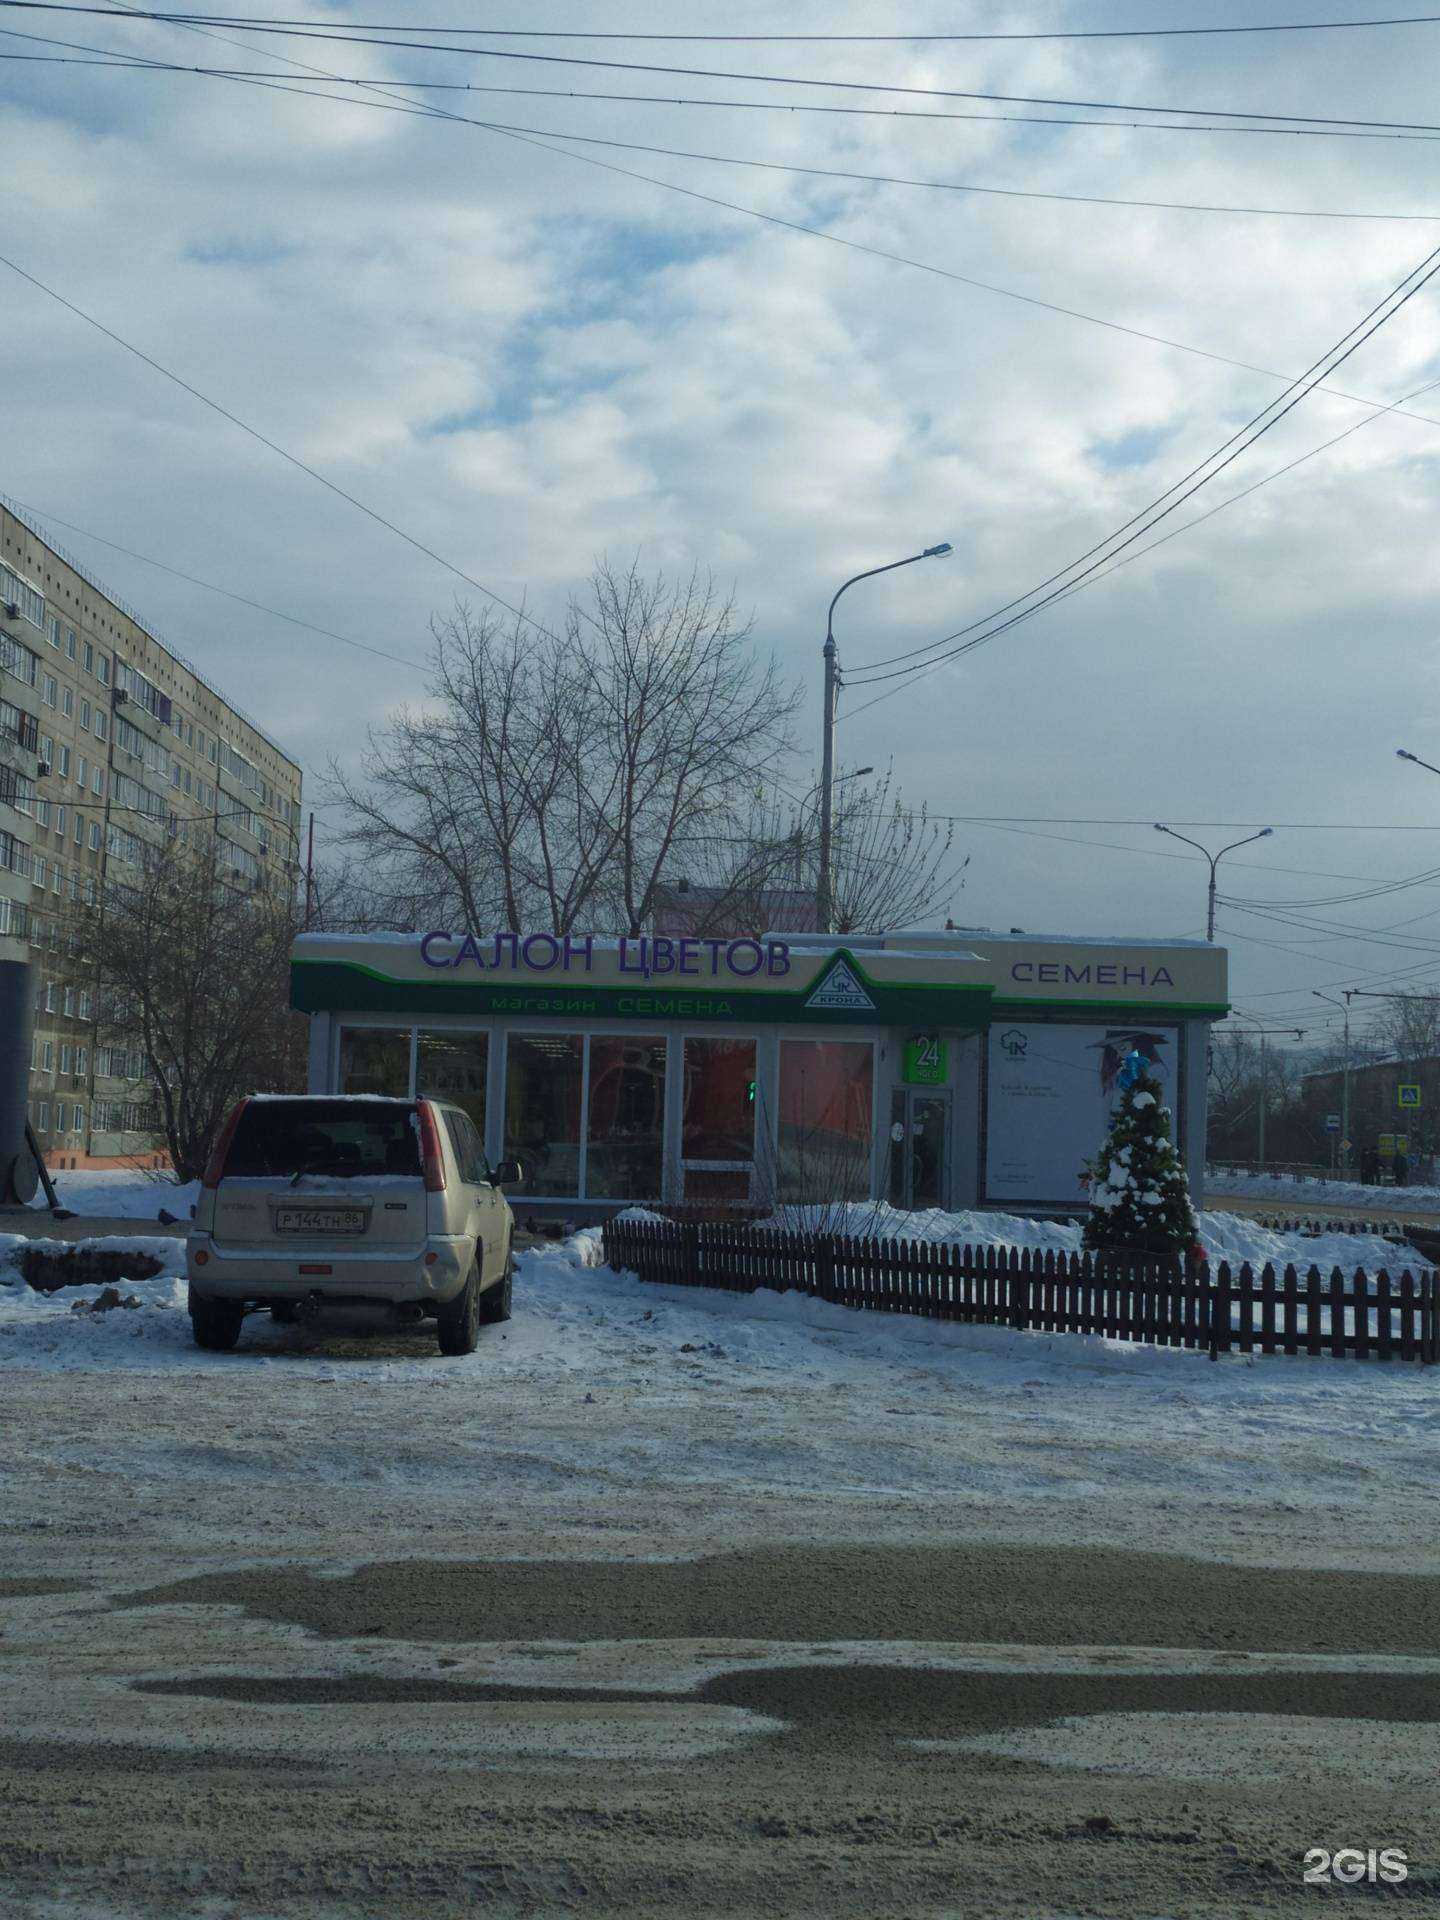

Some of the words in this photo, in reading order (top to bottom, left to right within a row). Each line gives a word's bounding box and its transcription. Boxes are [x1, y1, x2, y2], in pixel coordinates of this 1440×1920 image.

[420, 930, 593, 971] САЛОН
[618, 936, 792, 979] ЦВЕТОВ
[1011, 962, 1175, 987] СЕМЕНА
[491, 998, 597, 1012] магазин
[616, 998, 734, 1015] СЕМЕНА
[916, 1036, 940, 1067] 24
